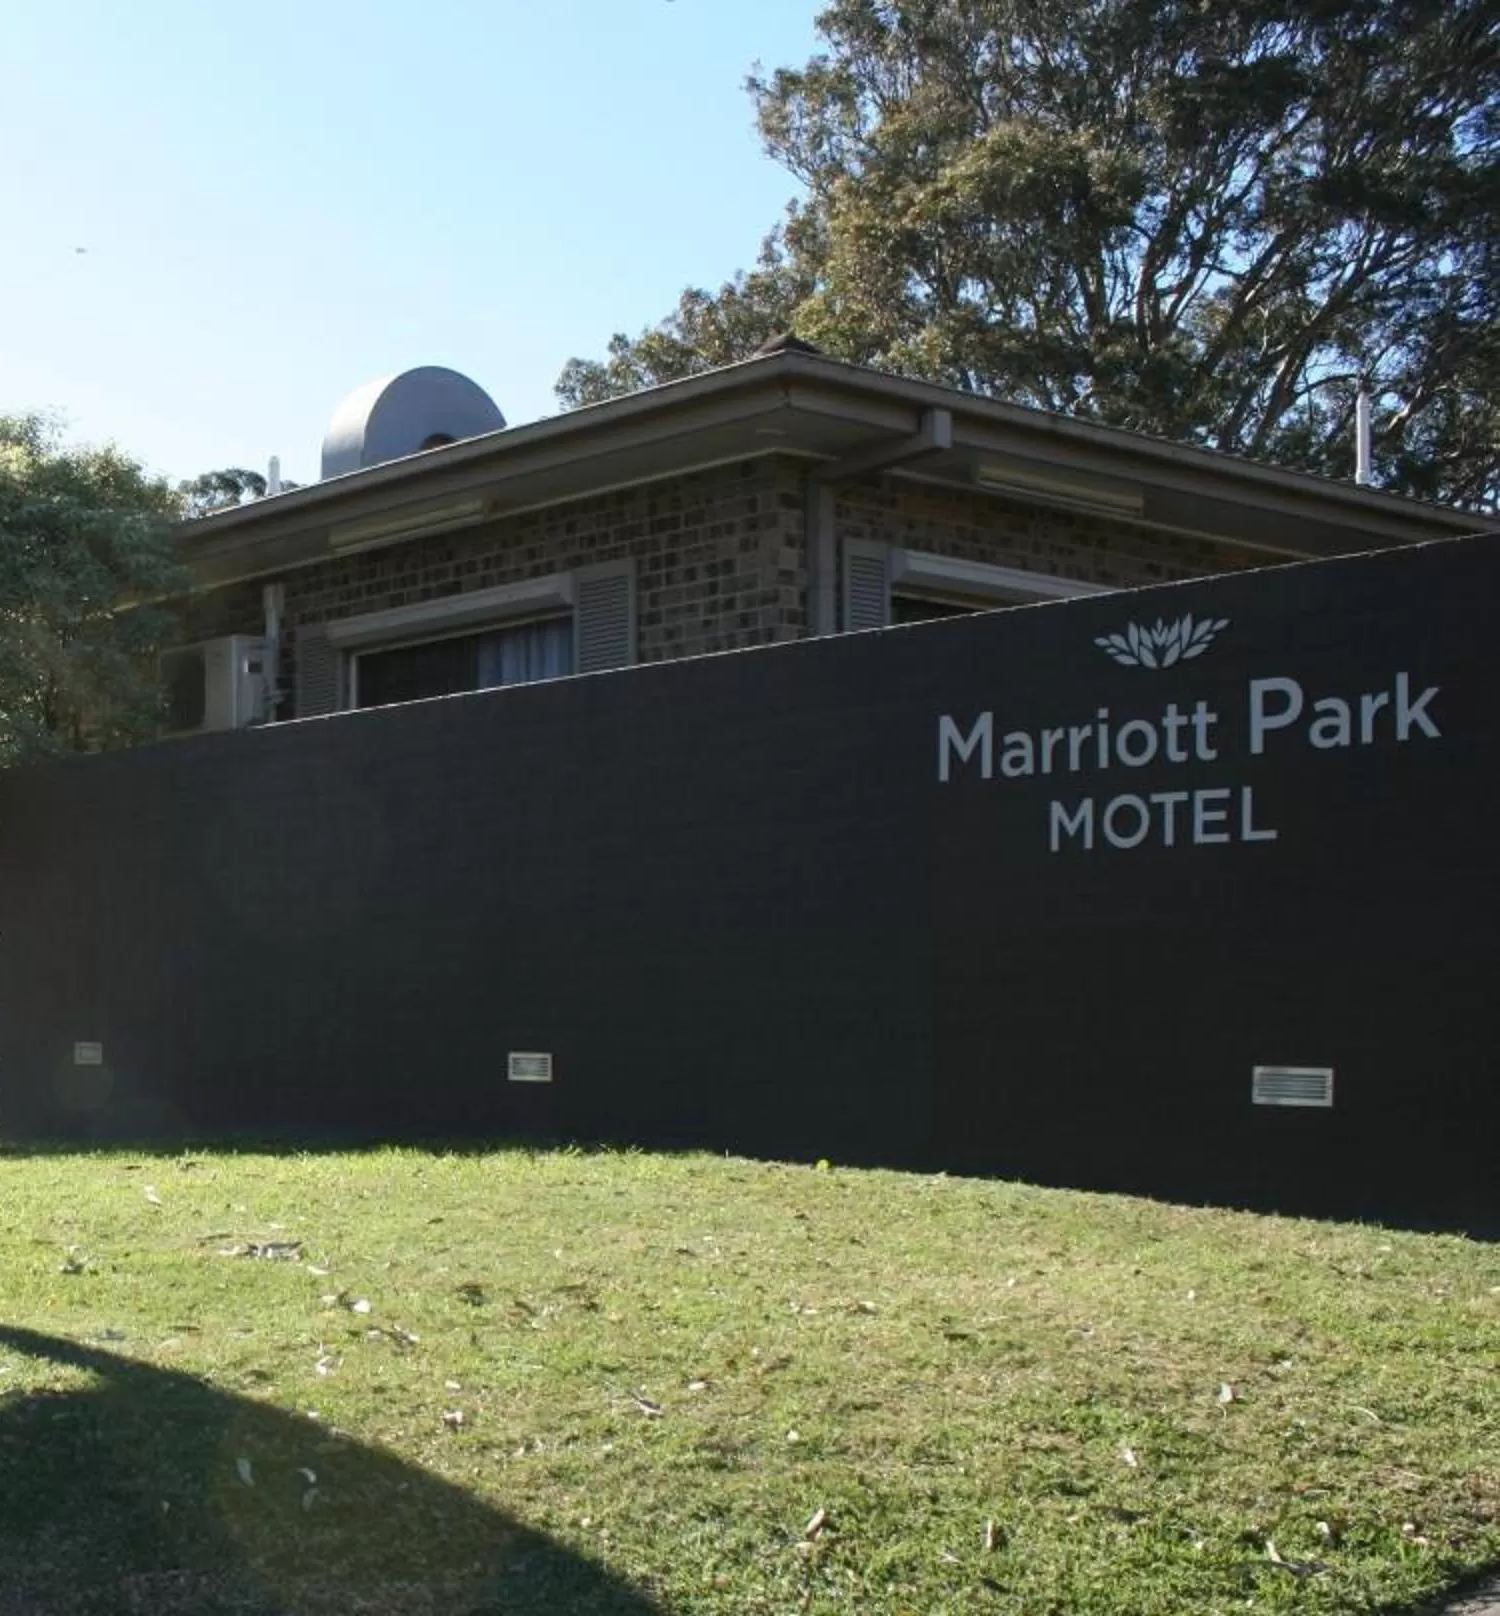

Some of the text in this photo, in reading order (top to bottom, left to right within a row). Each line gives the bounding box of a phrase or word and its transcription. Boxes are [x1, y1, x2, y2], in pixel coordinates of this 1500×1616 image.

[938, 672, 1442, 783] Marriott Park
[1049, 786, 1278, 853] MOTEL
